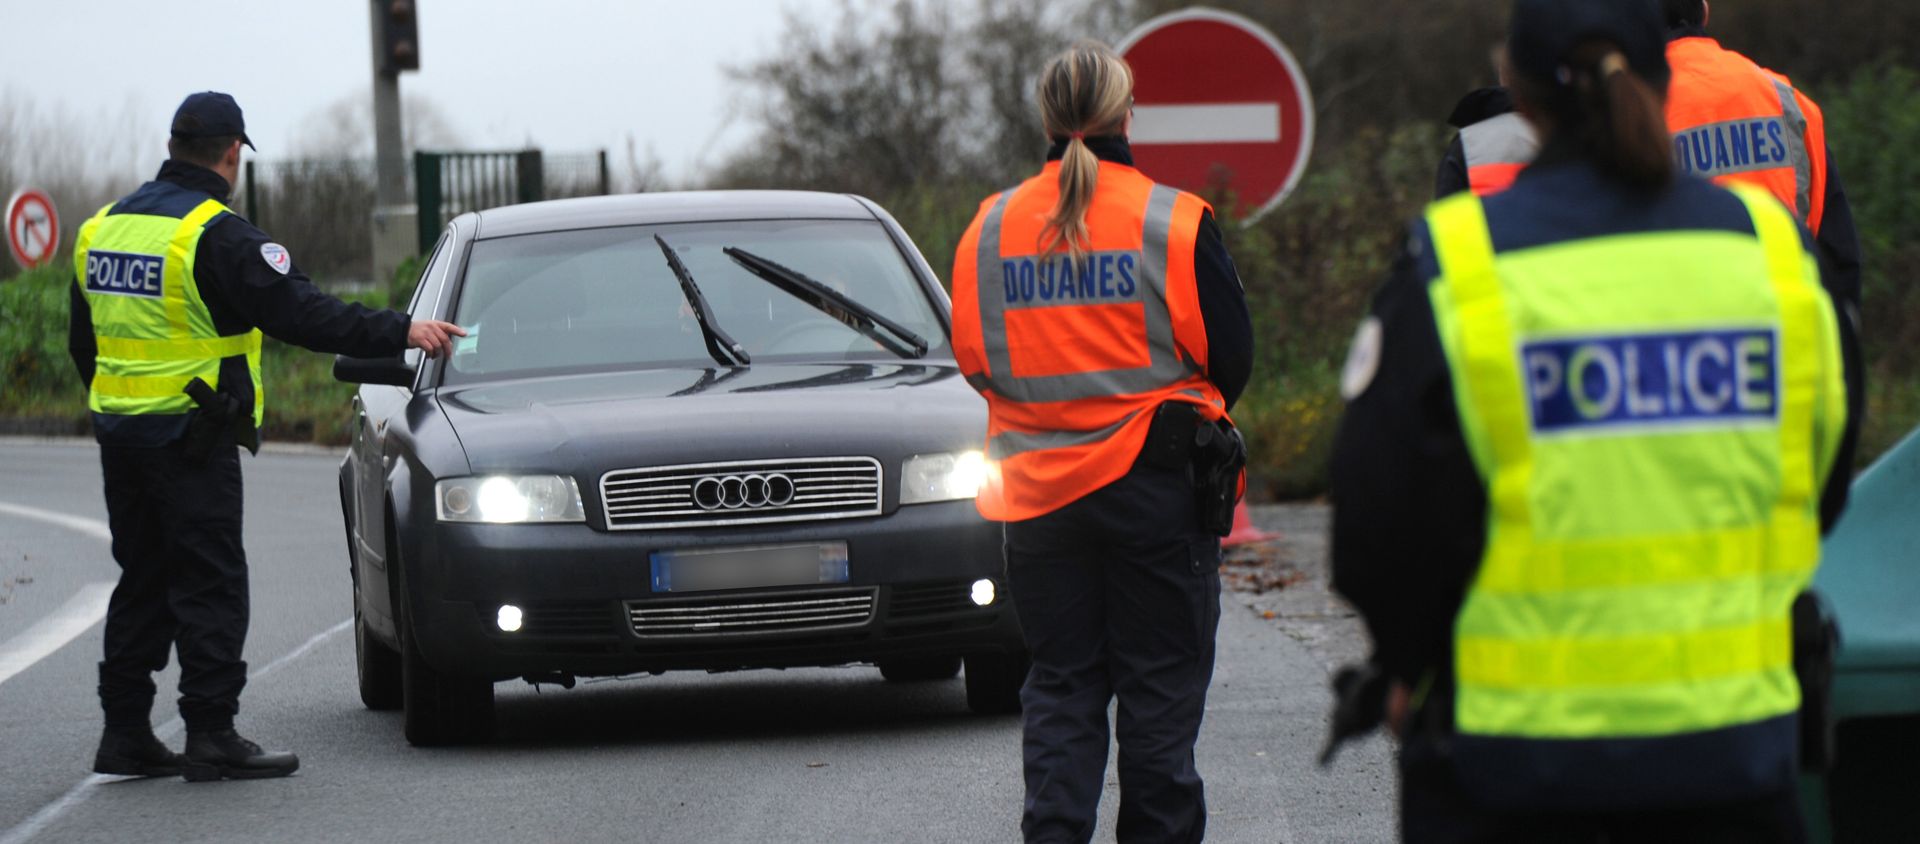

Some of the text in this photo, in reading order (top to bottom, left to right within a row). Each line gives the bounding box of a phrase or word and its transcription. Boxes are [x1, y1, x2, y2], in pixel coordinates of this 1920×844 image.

[1674, 120, 1786, 175] OUANES
[88, 256, 160, 291] POLICE
[1003, 254, 1135, 303] DOUANES
[1528, 336, 1771, 421] POLICE
